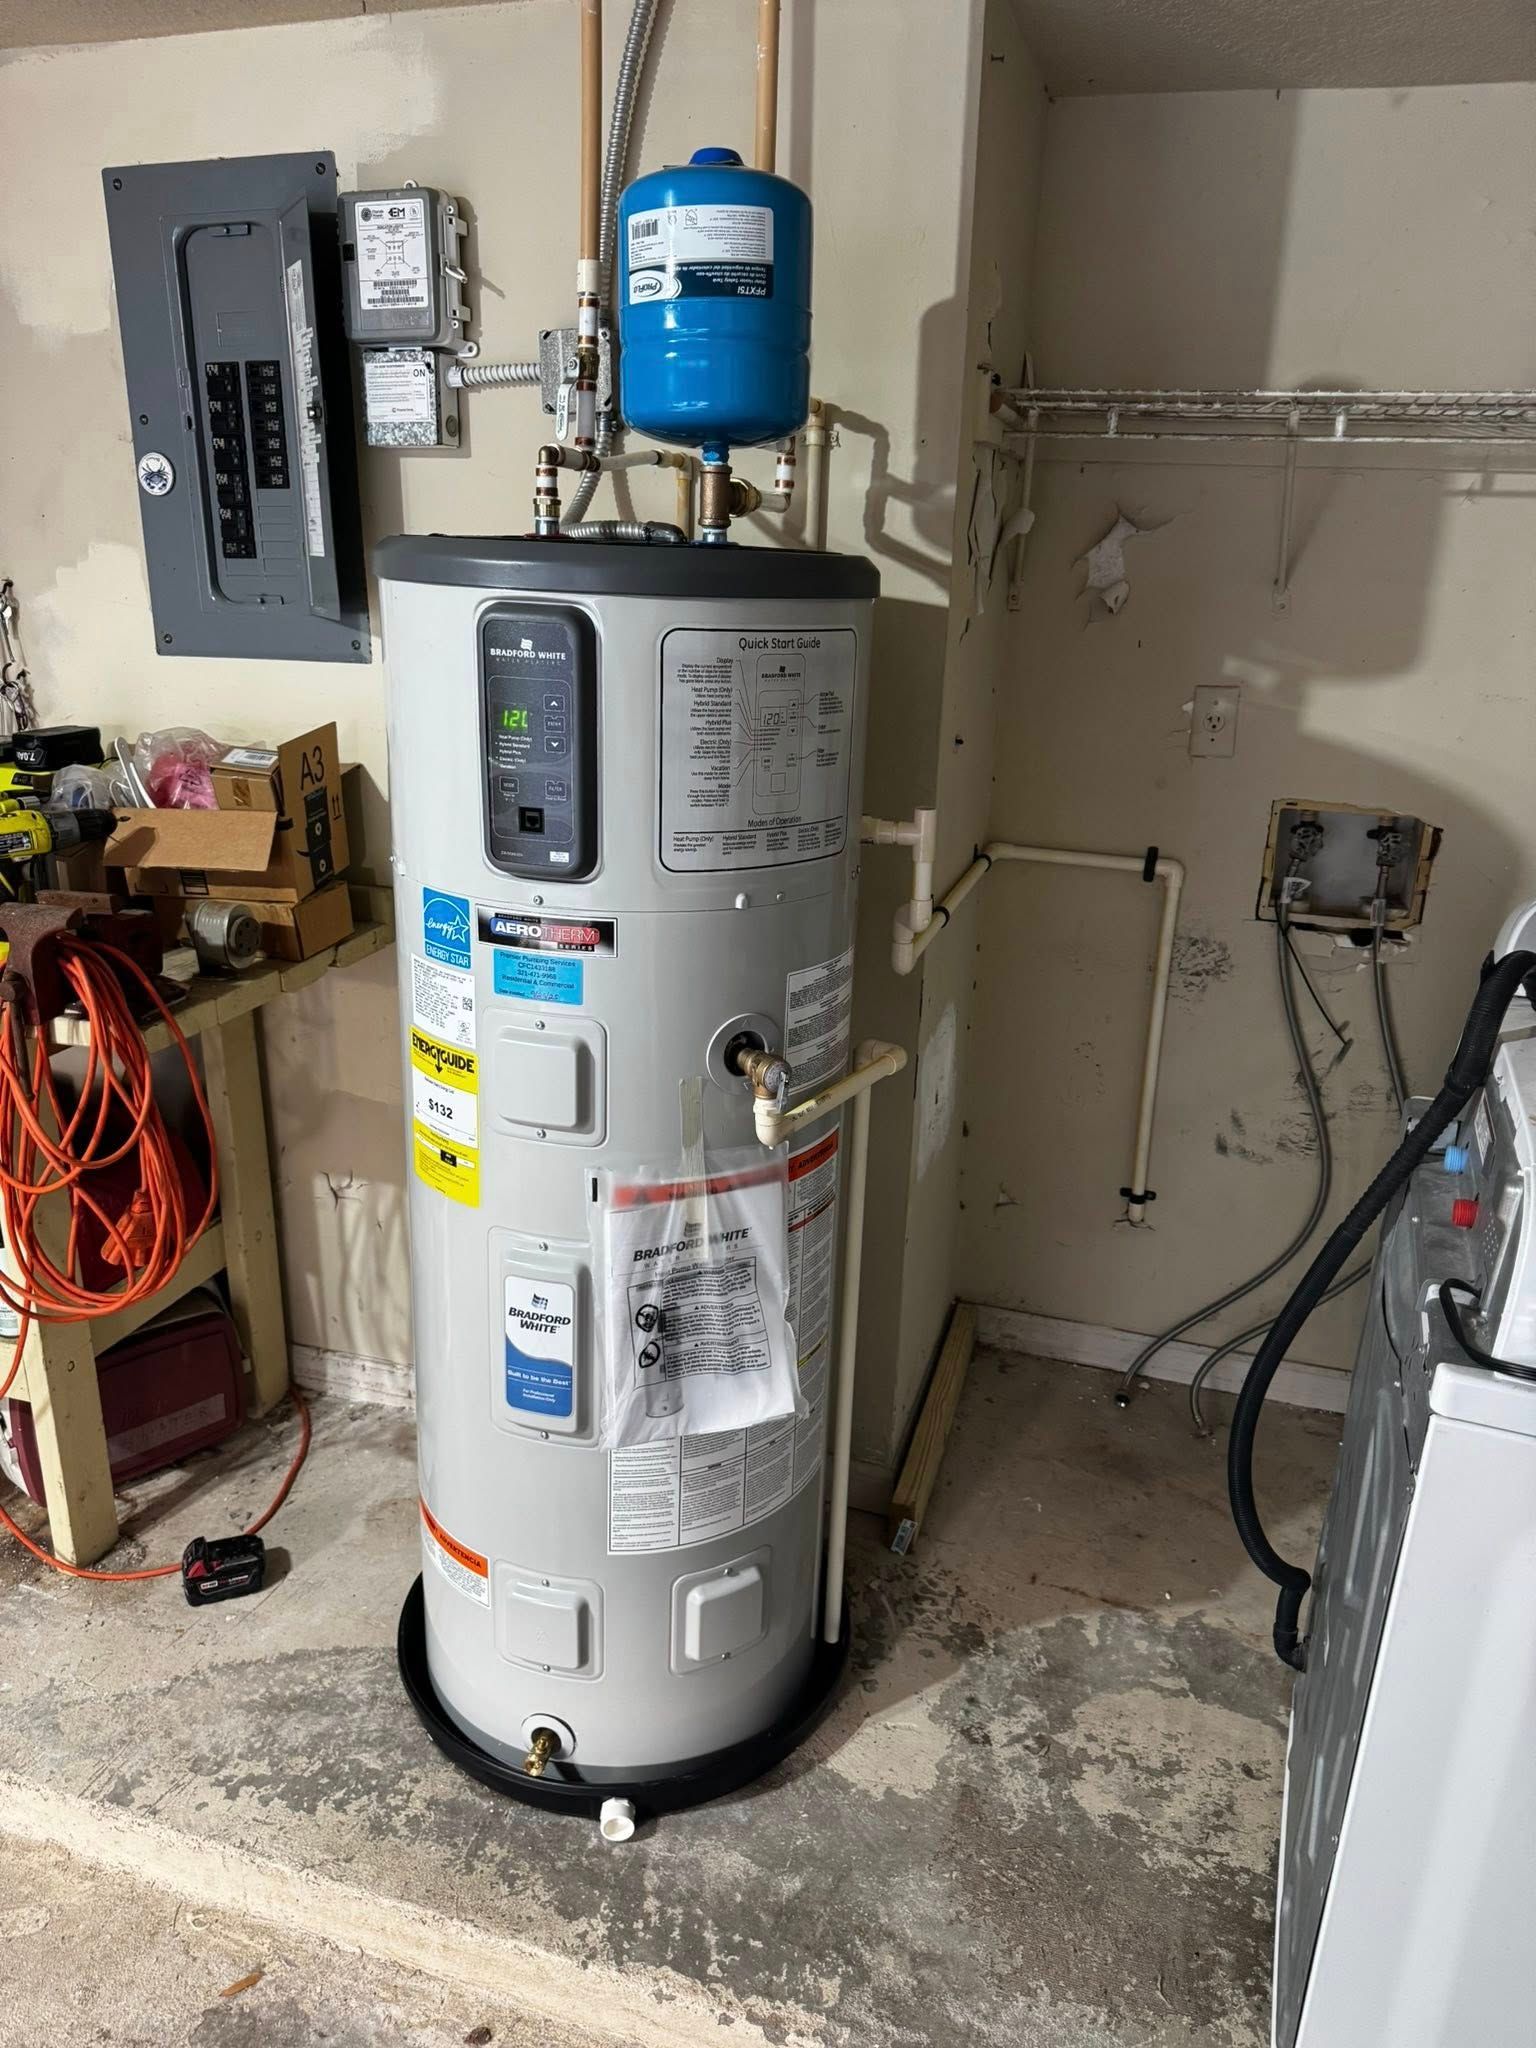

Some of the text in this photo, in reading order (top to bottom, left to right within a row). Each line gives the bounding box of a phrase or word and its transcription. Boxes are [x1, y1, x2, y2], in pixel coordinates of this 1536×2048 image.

[413, 368, 426, 377] ON
[738, 637, 821, 651] Quick Start Guide
[490, 648, 566, 660] BRADFORD WHITE
[716, 657, 733, 665] Display
[763, 713, 780, 725] 120
[301, 745, 325, 791] A3
[748, 818, 769, 827] Modes
[776, 816, 801, 825] Operation
[686, 836, 699, 844] Pump
[494, 921, 596, 942] AEROTHERM
[426, 944, 469, 967] ENERGY STAR
[522, 955, 549, 965] Plumbing
[550, 958, 576, 967] Services
[502, 974, 532, 985] Residential
[539, 980, 576, 989] Commercial
[412, 1032, 475, 1074] ENERGYGUIDE
[428, 1098, 453, 1120] $132
[633, 1238, 703, 1262] BRADFORD
[708, 1228, 750, 1244] WHITE
[508, 1306, 571, 1326] BRADFORD
[520, 1319, 557, 1334] WHITE
[507, 1369, 522, 1379] Built
[541, 1375, 552, 1383] the
[552, 1377, 569, 1386] Best
